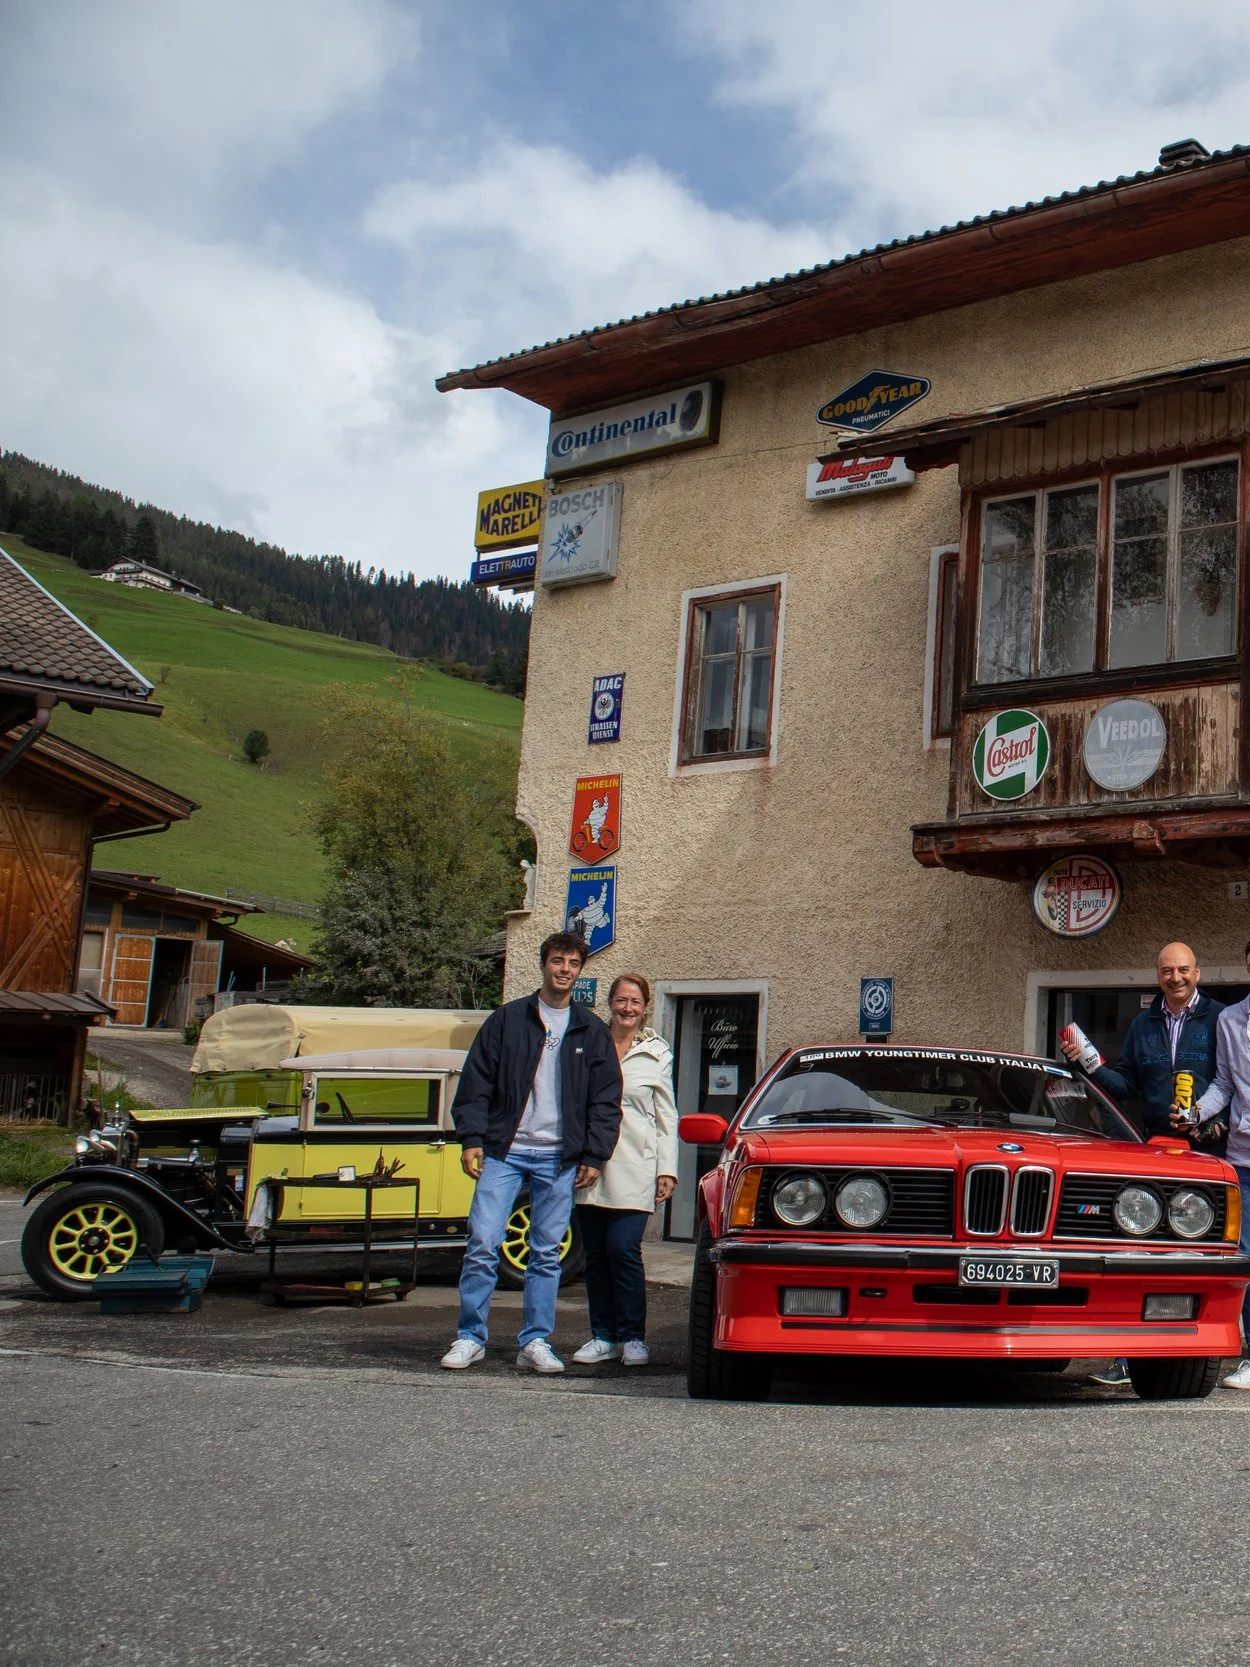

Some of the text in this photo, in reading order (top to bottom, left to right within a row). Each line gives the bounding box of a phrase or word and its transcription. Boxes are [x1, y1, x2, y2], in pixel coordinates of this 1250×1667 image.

[852, 409, 890, 424] PNEUMATICI
[551, 403, 677, 457] Continental
[870, 471, 888, 480] MOTO
[815, 477, 897, 496] VENDITA ASSISTENZA RICAMBI
[549, 488, 604, 518] BOSCH
[479, 556, 535, 574] ELETTRAUTO
[593, 677, 622, 692] ADAC
[1097, 716, 1160, 749] VEEDOL
[987, 726, 1037, 777] Castrol
[577, 778, 619, 791] MICHELIN
[571, 871, 613, 882] MICHELIN
[1061, 875, 1110, 889] DUCATI
[1235, 884, 1241, 896] 2
[1072, 899, 1107, 910] SERVIZIO
[708, 1033, 739, 1059] Ufficio
[825, 1050, 861, 1059] BMW
[864, 1050, 957, 1060] YOUNGTIMER
[959, 1053, 995, 1064] CLUB
[999, 1058, 1042, 1071] ITALIA
[967, 1264, 1051, 1281] 694025 VR
